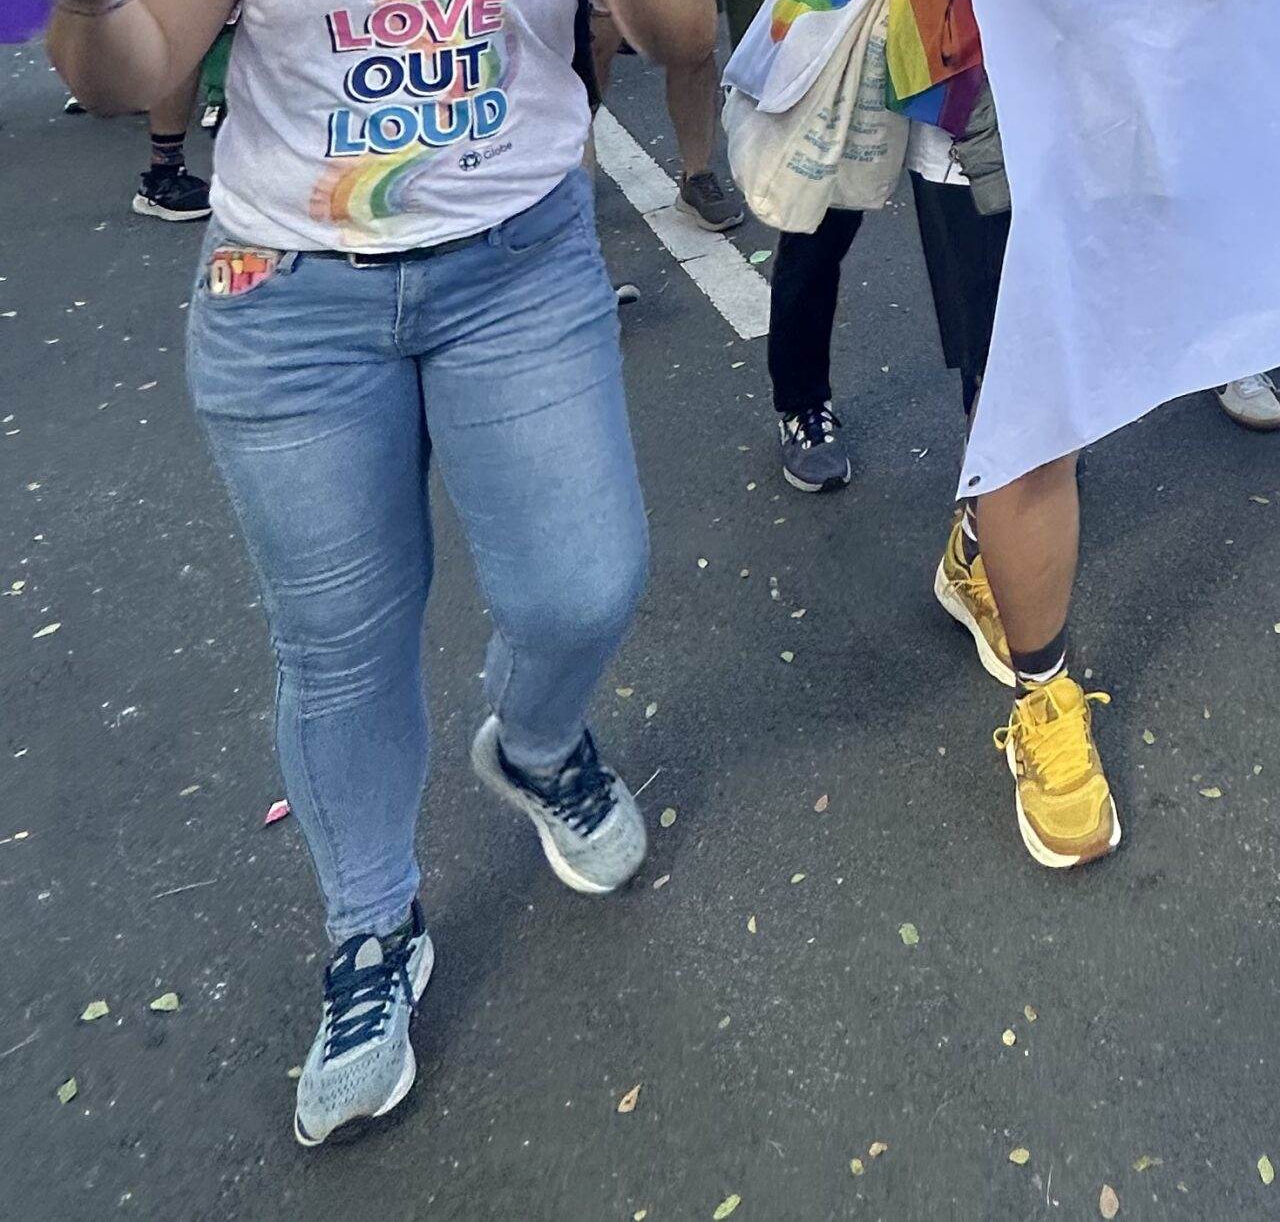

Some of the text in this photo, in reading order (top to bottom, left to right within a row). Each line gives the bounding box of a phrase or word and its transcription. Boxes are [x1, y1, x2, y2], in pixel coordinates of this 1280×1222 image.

[344, 41, 490, 103] OUT
[326, 89, 508, 158] LOUD
[483, 142, 512, 159] Globe
